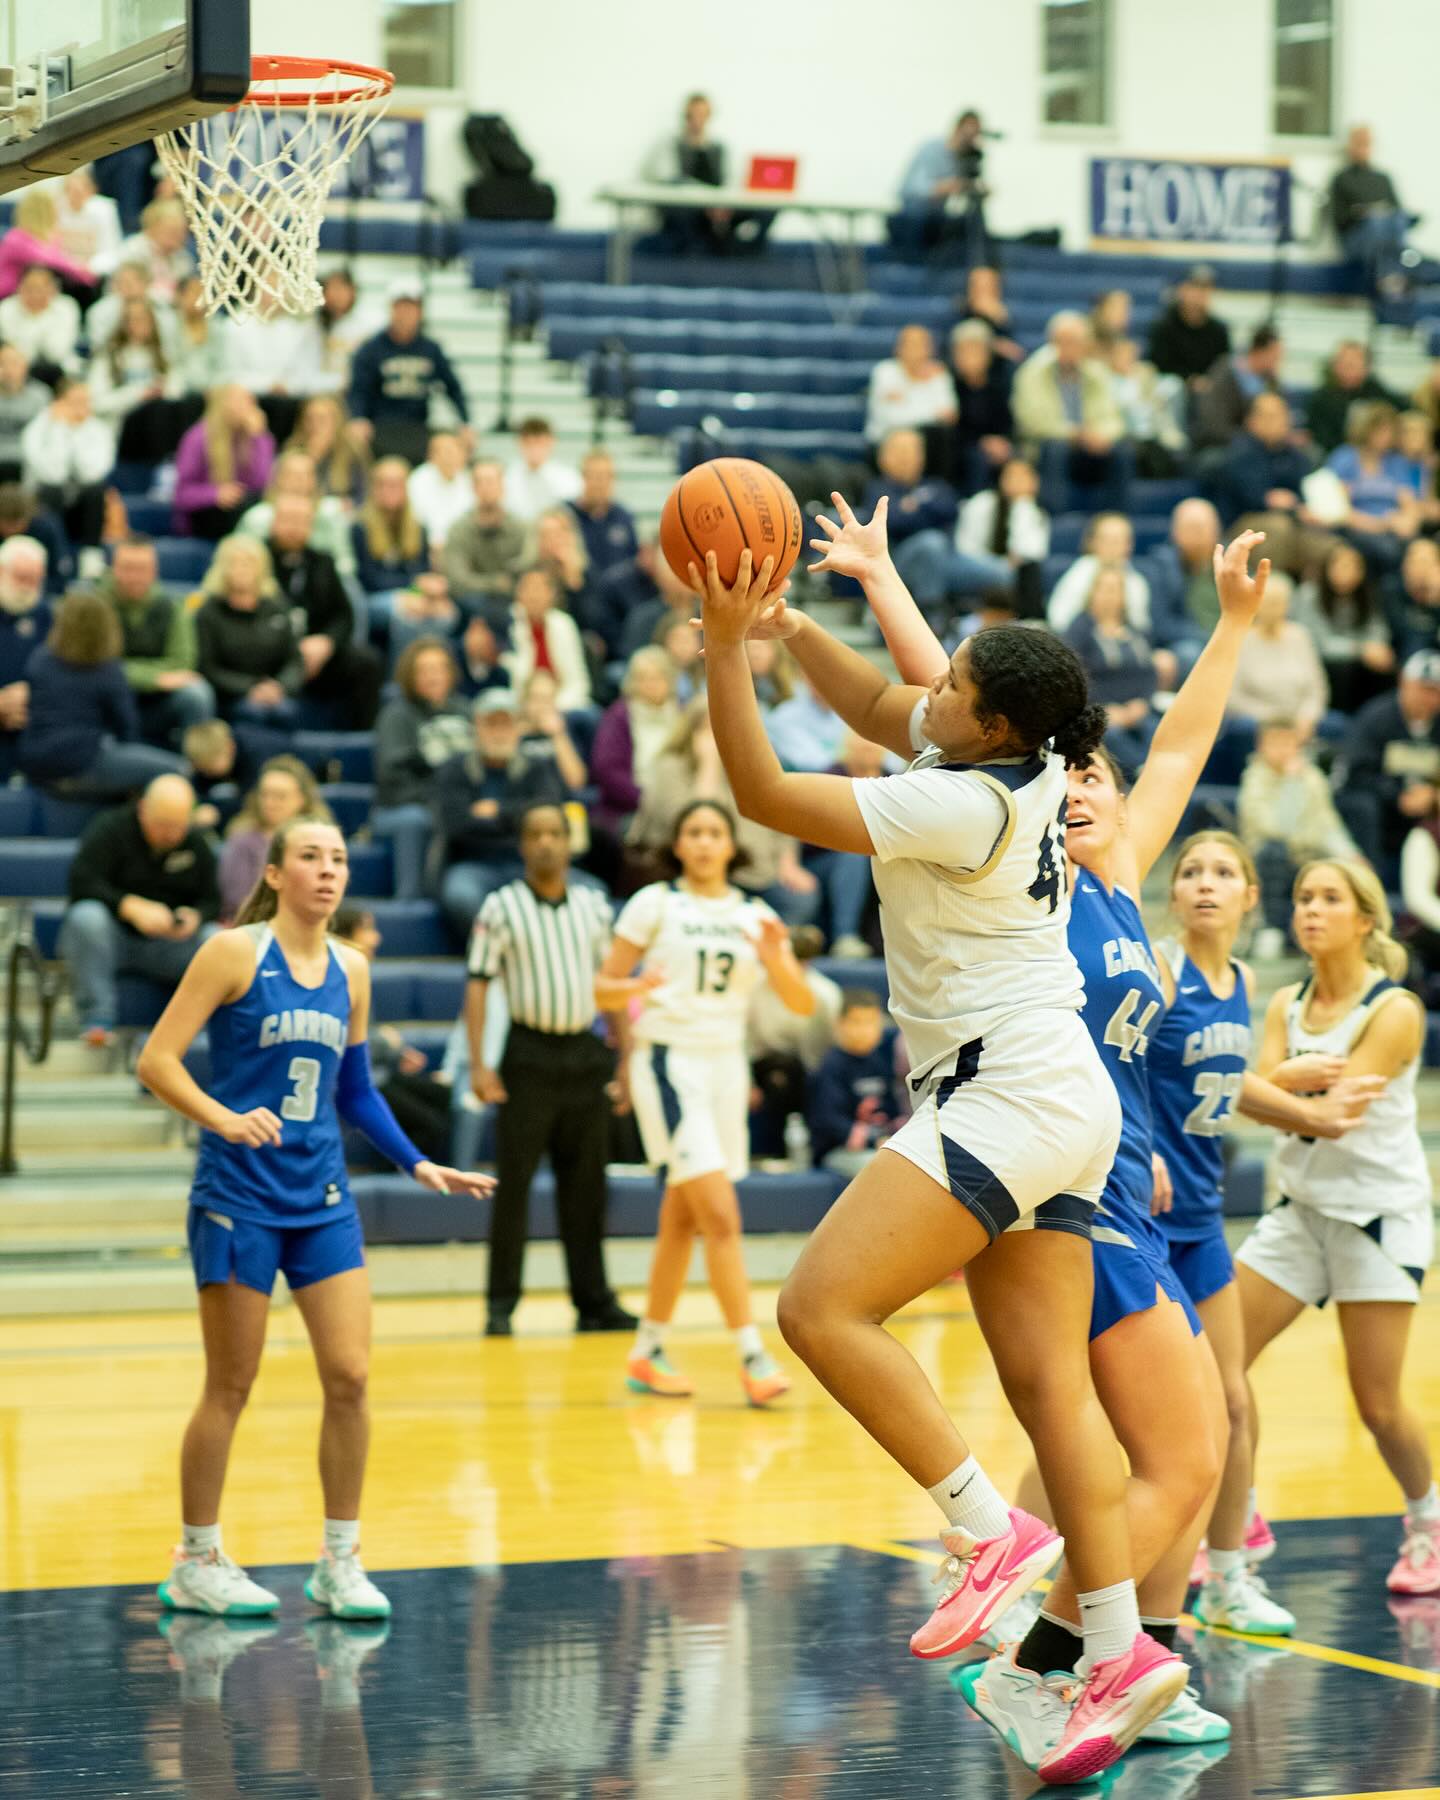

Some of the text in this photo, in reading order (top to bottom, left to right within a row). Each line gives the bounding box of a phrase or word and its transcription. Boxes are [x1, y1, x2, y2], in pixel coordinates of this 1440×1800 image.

[1103, 161, 1280, 238] HOME
[697, 948, 735, 994] 13
[1103, 987, 1160, 1063] 44
[280, 1056, 321, 1122] 3
[1182, 1071, 1244, 1138] 23
